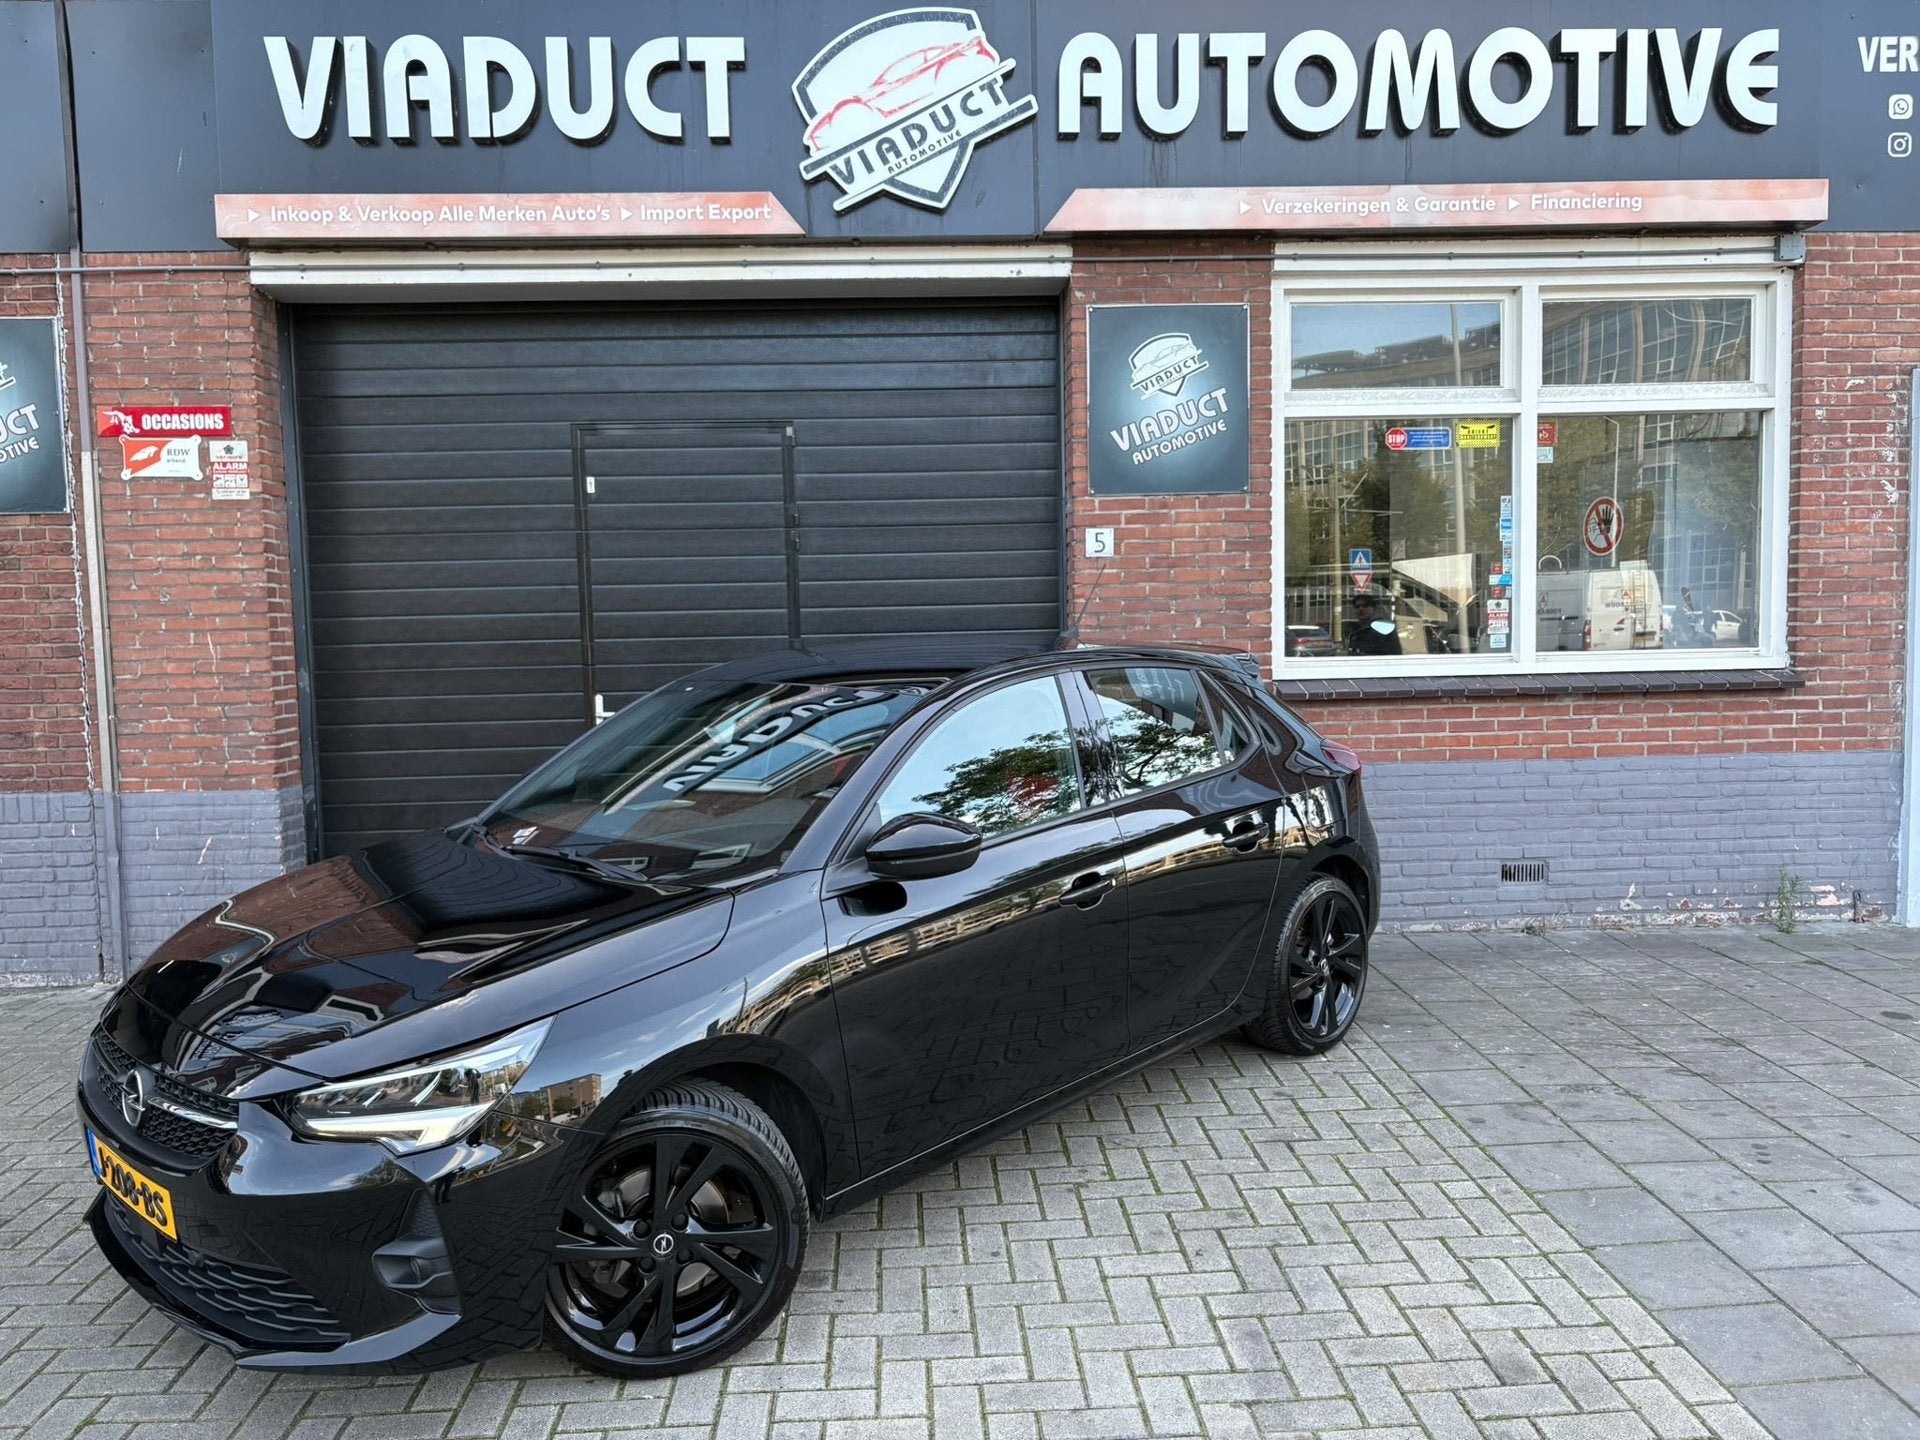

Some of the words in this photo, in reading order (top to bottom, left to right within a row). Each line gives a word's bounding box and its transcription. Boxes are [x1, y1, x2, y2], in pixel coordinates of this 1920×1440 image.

[1857, 35, 1919, 72] VER
[263, 35, 746, 142] VIADUCT
[1057, 27, 1780, 137] AUTOMOTIVE
[829, 77, 1003, 185] VIADUCT
[887, 129, 962, 174] AUTOMOTIVE
[271, 206, 334, 225] Inkoop
[338, 207, 351, 222] &
[357, 206, 434, 226] Verkoop
[438, 205, 474, 222] Alle
[478, 205, 546, 222] Merken
[551, 204, 611, 222] Auto's
[640, 204, 704, 224] Import
[708, 203, 772, 221] Export
[1262, 198, 1391, 217] Verzekeringen
[1395, 197, 1409, 213] &
[1414, 195, 1497, 213] Garantie
[1531, 192, 1643, 212] Financiering
[1140, 355, 1197, 391] VIADUCT
[141, 413, 224, 430] OCCASIONS
[1110, 387, 1229, 452] VIADUCT
[166, 448, 190, 456] RDW
[1132, 418, 1228, 466] AUTOMOTIVE
[1387, 434, 1405, 443] STOP
[213, 462, 248, 470] ALARM
[1093, 532, 1106, 553] 5
